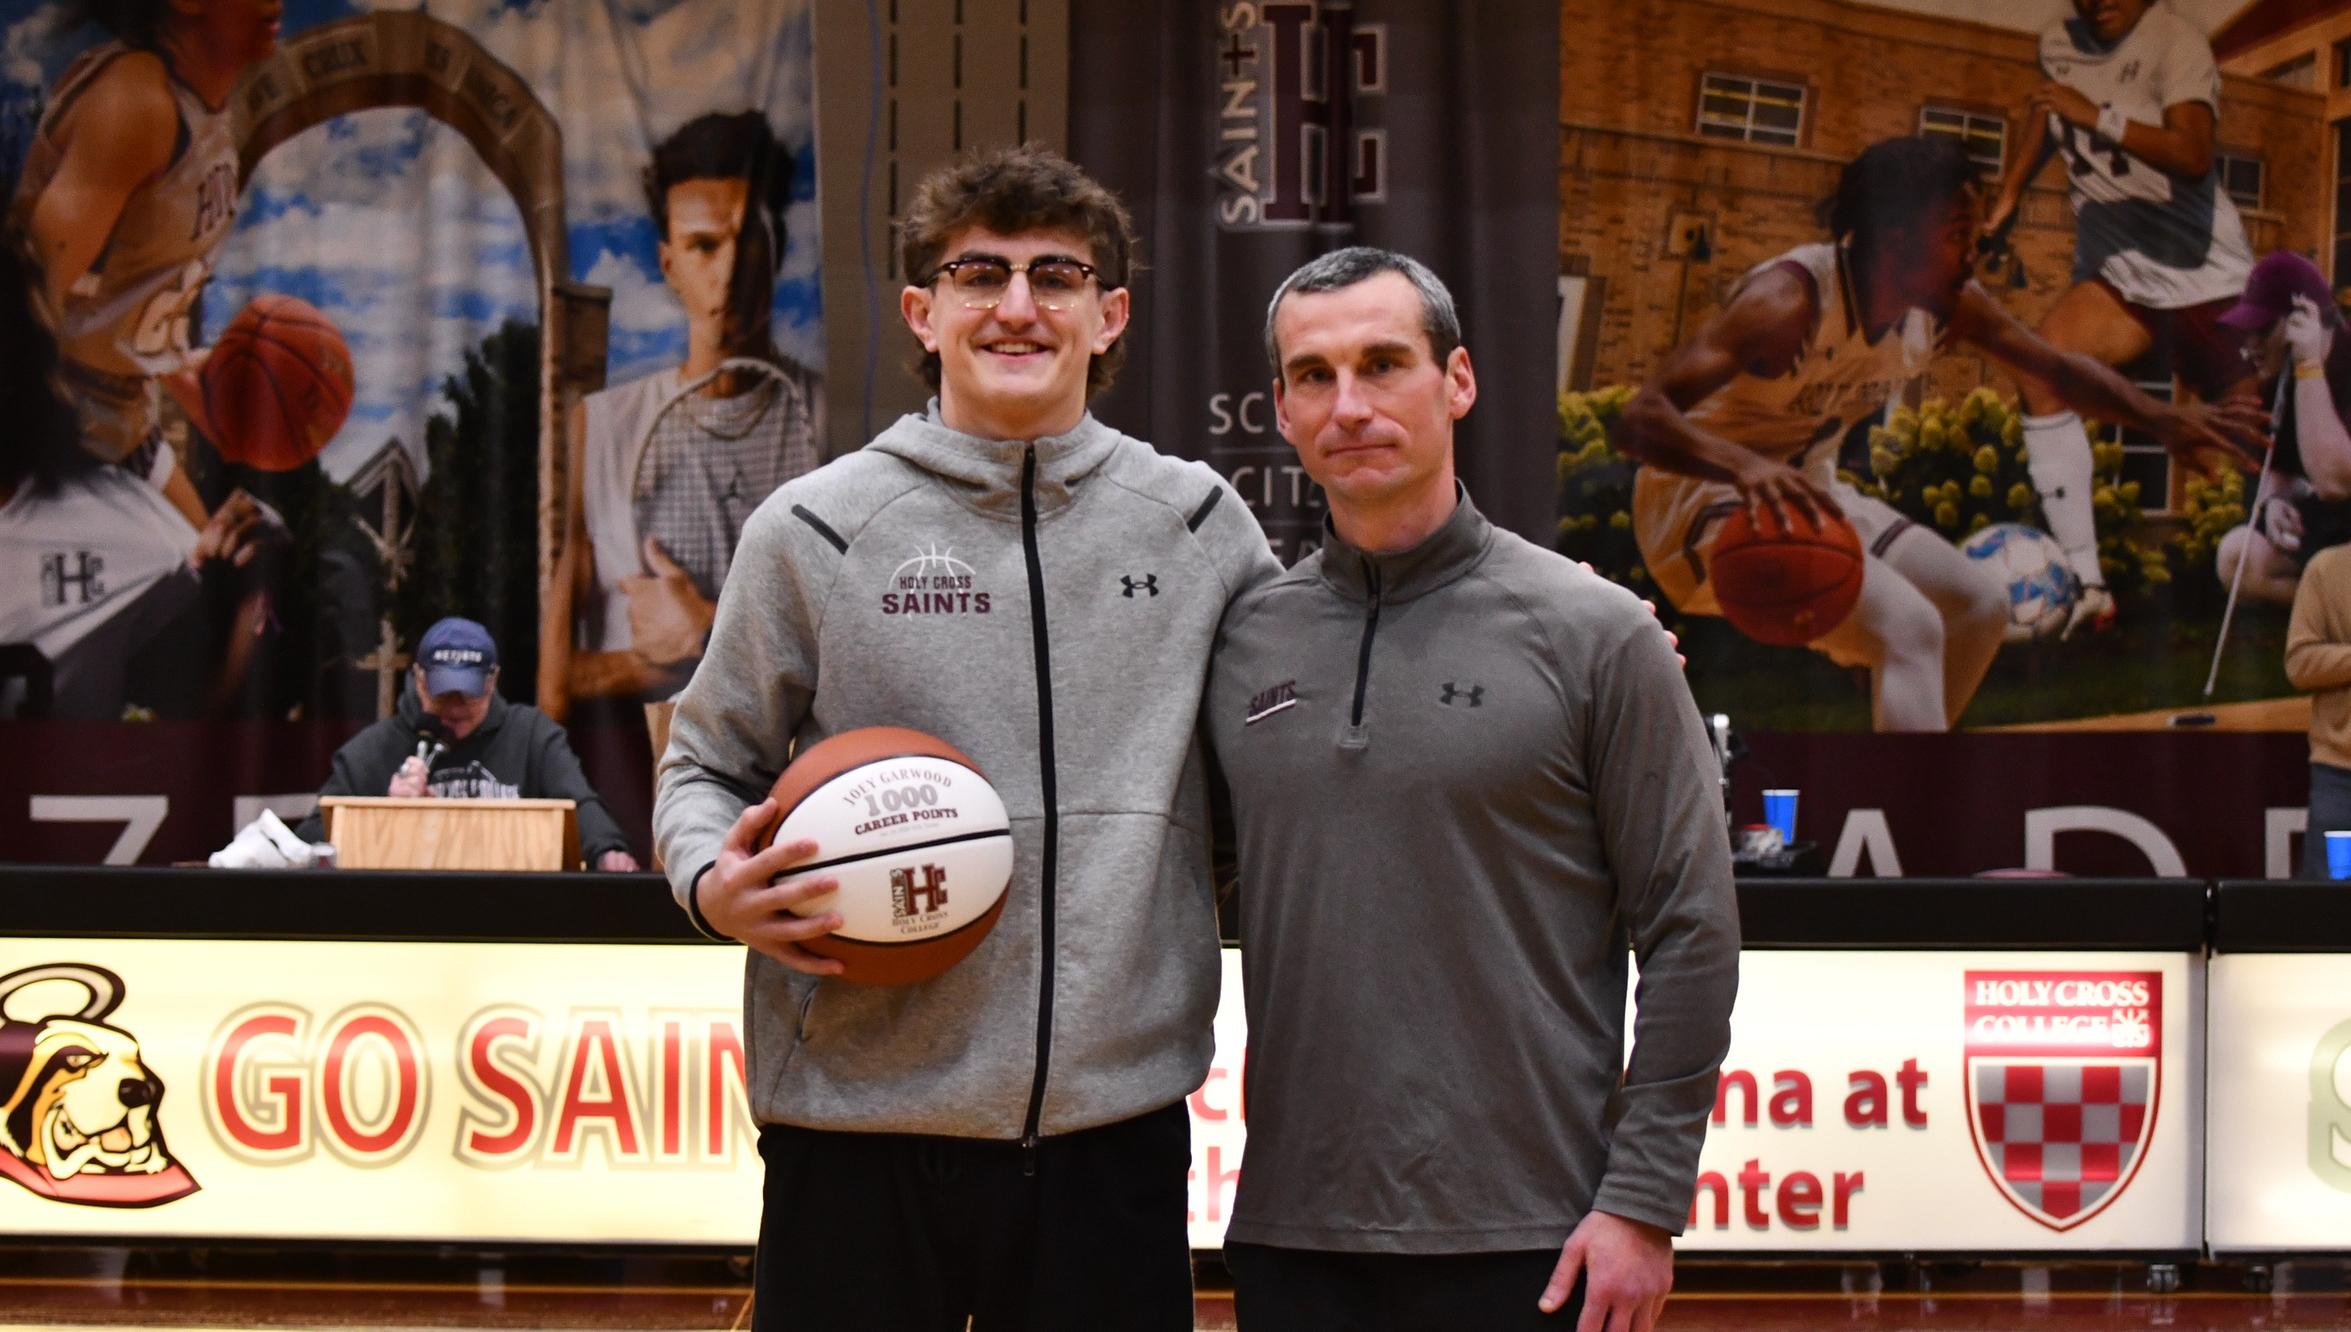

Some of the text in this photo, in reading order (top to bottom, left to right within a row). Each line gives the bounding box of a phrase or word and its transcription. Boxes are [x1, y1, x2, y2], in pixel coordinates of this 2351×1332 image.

[1231, 466, 1321, 507] CIT
[899, 575, 972, 589] HOLY CROSS
[882, 592, 991, 614] SAINTS
[843, 768, 952, 806] JOEY GARWOOD
[864, 784, 939, 817] 1000
[854, 813, 909, 835] CAREER
[913, 808, 958, 821] POINTS
[1975, 980, 2150, 1007] HOLY CROSS
[1973, 1015, 2110, 1044] COLLEGE
[204, 1003, 430, 1168] GO
[1844, 1057, 1929, 1129] at
